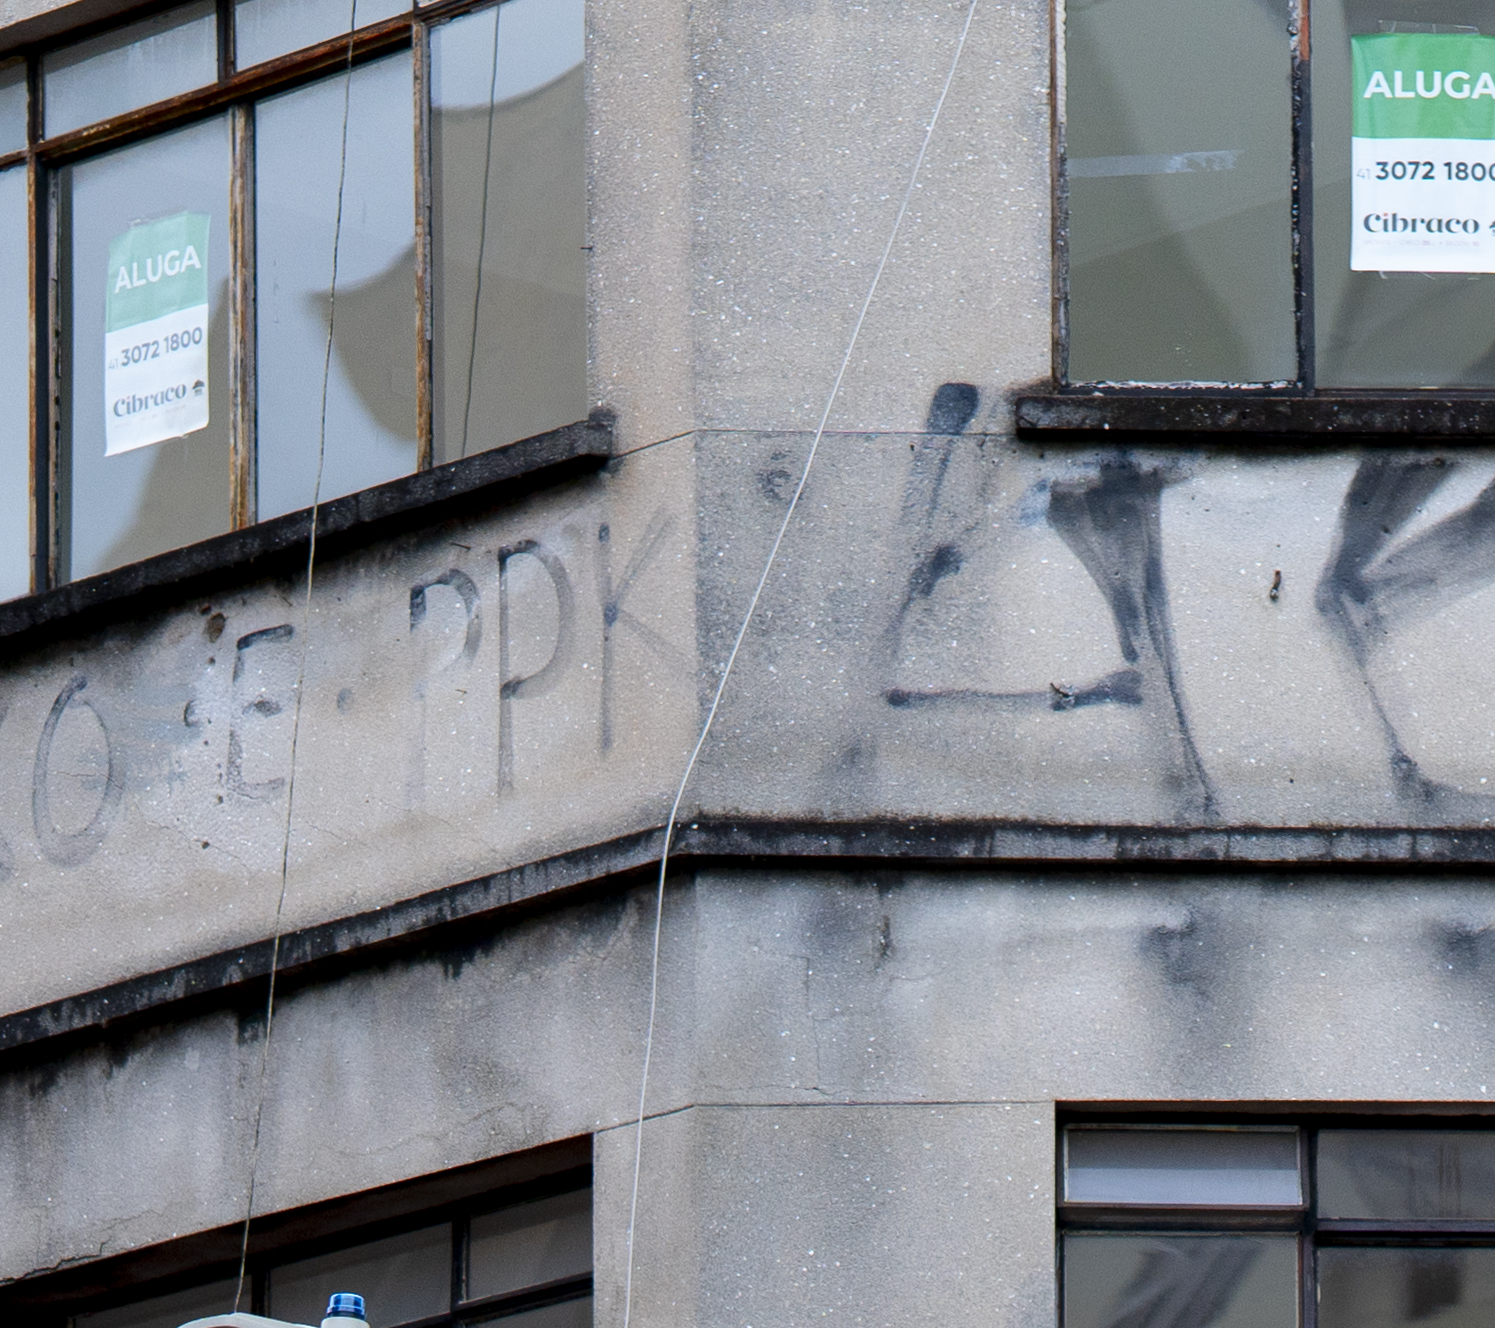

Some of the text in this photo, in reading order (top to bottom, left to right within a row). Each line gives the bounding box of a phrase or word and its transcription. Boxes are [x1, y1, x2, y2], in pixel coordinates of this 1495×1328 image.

[1375, 161, 1435, 181] 3072
[1363, 212, 1480, 235] Cibraco
[113, 244, 202, 294] ALUGA
[121, 339, 161, 368] 3072
[164, 326, 203, 354] 1800
[113, 383, 188, 418] Cibraco
